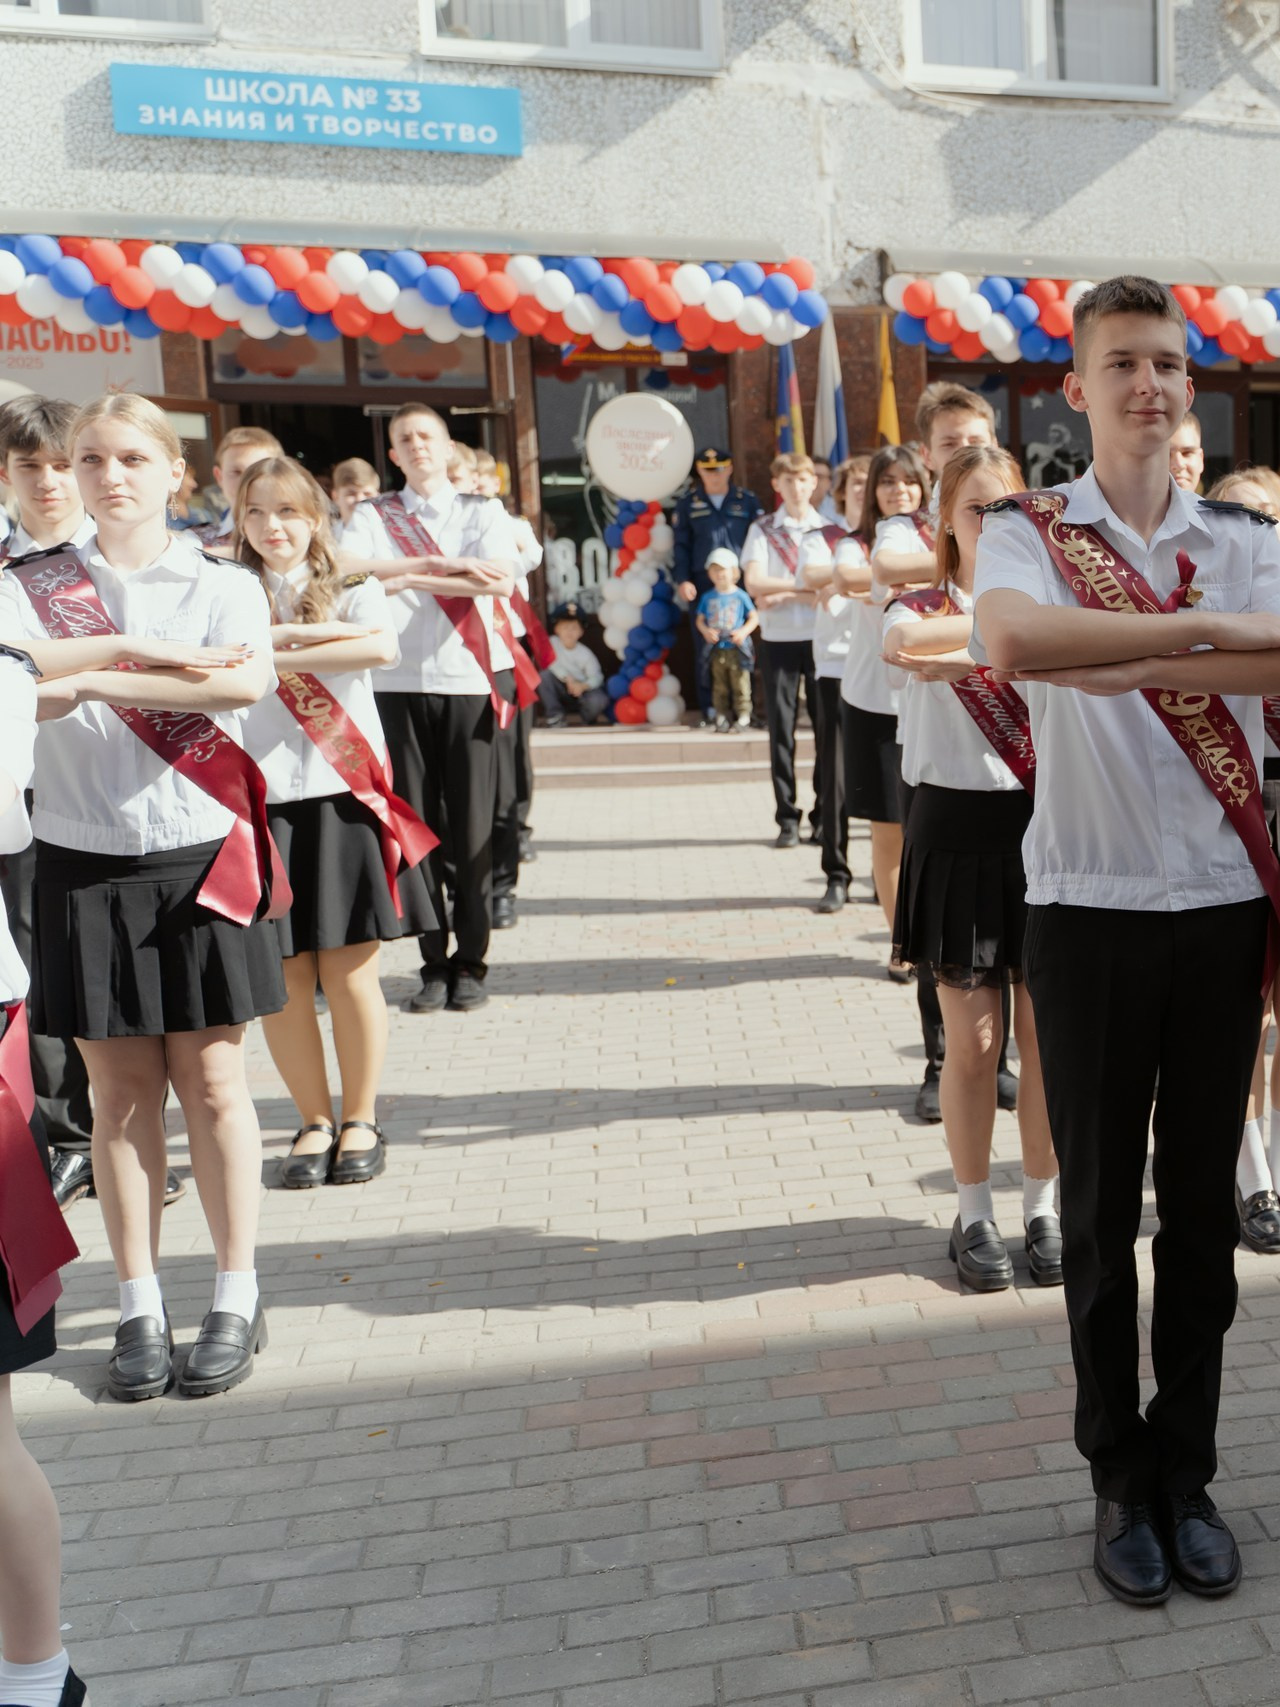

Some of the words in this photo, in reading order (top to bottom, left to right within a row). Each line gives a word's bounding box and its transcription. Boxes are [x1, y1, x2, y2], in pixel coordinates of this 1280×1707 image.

[204, 76, 334, 109] ШКОЛА
[342, 85, 379, 111] №
[386, 88, 422, 114] 33
[138, 104, 266, 131] ЗНАНИЯ
[276, 113, 295, 133] И
[303, 114, 499, 145] ТВОРЧЕСТВО
[0, 319, 132, 354] АСИБО!
[296, 696, 333, 717] 9
[1159, 691, 1211, 717] 9
[1183, 713, 1250, 808] КЛАССА
